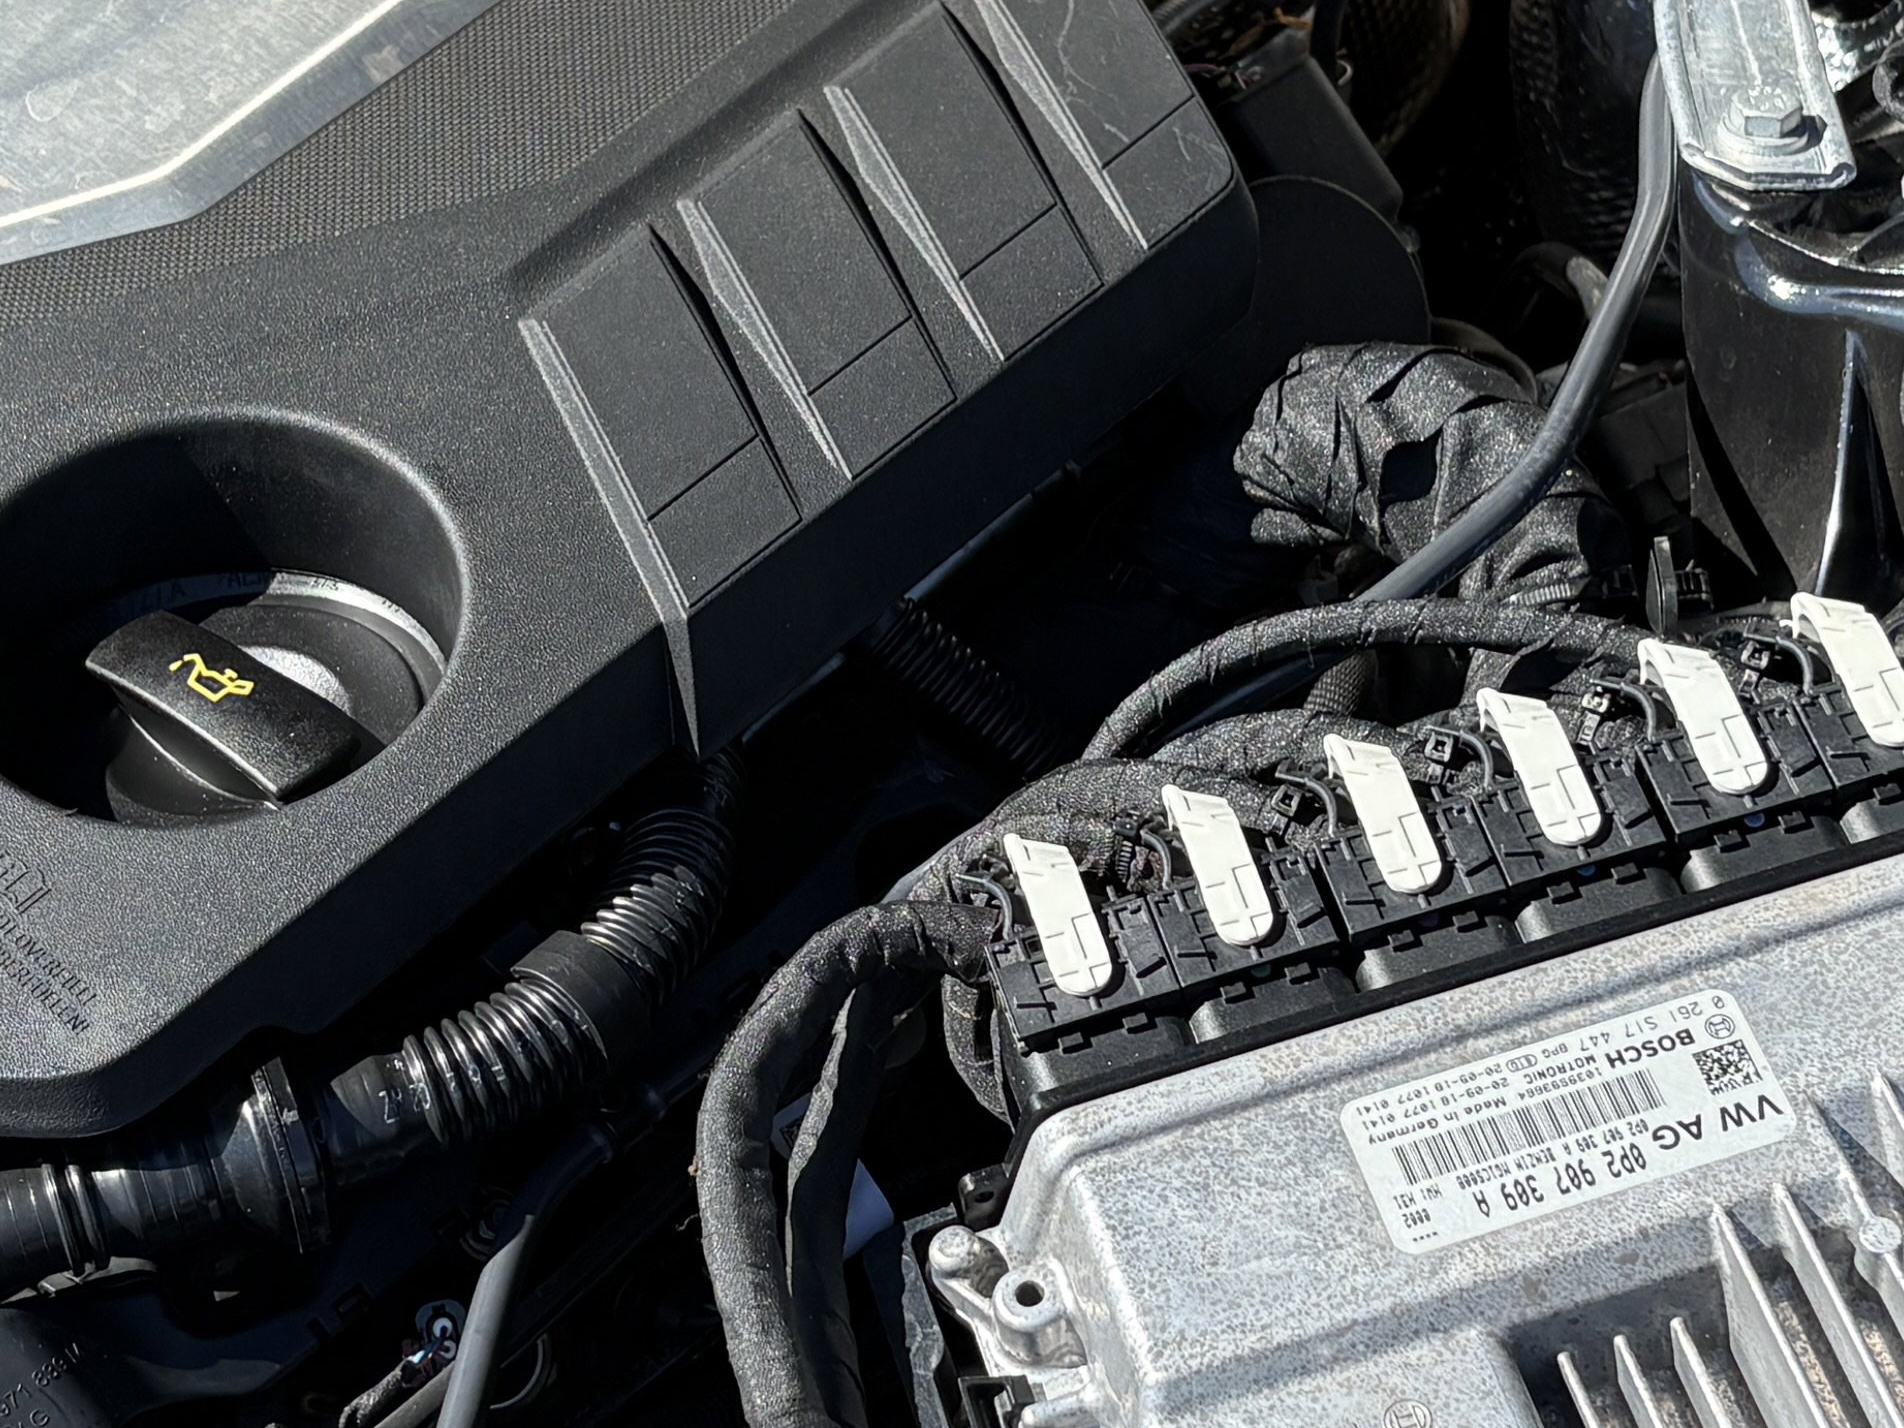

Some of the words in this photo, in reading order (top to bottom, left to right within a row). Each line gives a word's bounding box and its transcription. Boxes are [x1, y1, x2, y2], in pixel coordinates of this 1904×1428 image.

[1669, 1001, 1703, 1022] 261
[1580, 1032, 1610, 1052] 447
[1605, 1028, 1695, 1068] BOSCH
[1523, 1054, 1597, 1085] MOTRONIC
[1443, 1111, 1460, 1122] in
[1463, 1096, 1507, 1115] Made
[1720, 1094, 1783, 1132] VW
[1368, 1118, 1439, 1145] Germany
[1575, 1134, 1598, 1153] 309
[1602, 1126, 1624, 1145] 907
[1647, 1114, 1702, 1150] AG
[1562, 1142, 1572, 1156] A
[1601, 1143, 1647, 1178] 0P2
[1554, 1159, 1596, 1195] 907
[1472, 1190, 1491, 1218] A
[1500, 1174, 1544, 1211] 309
